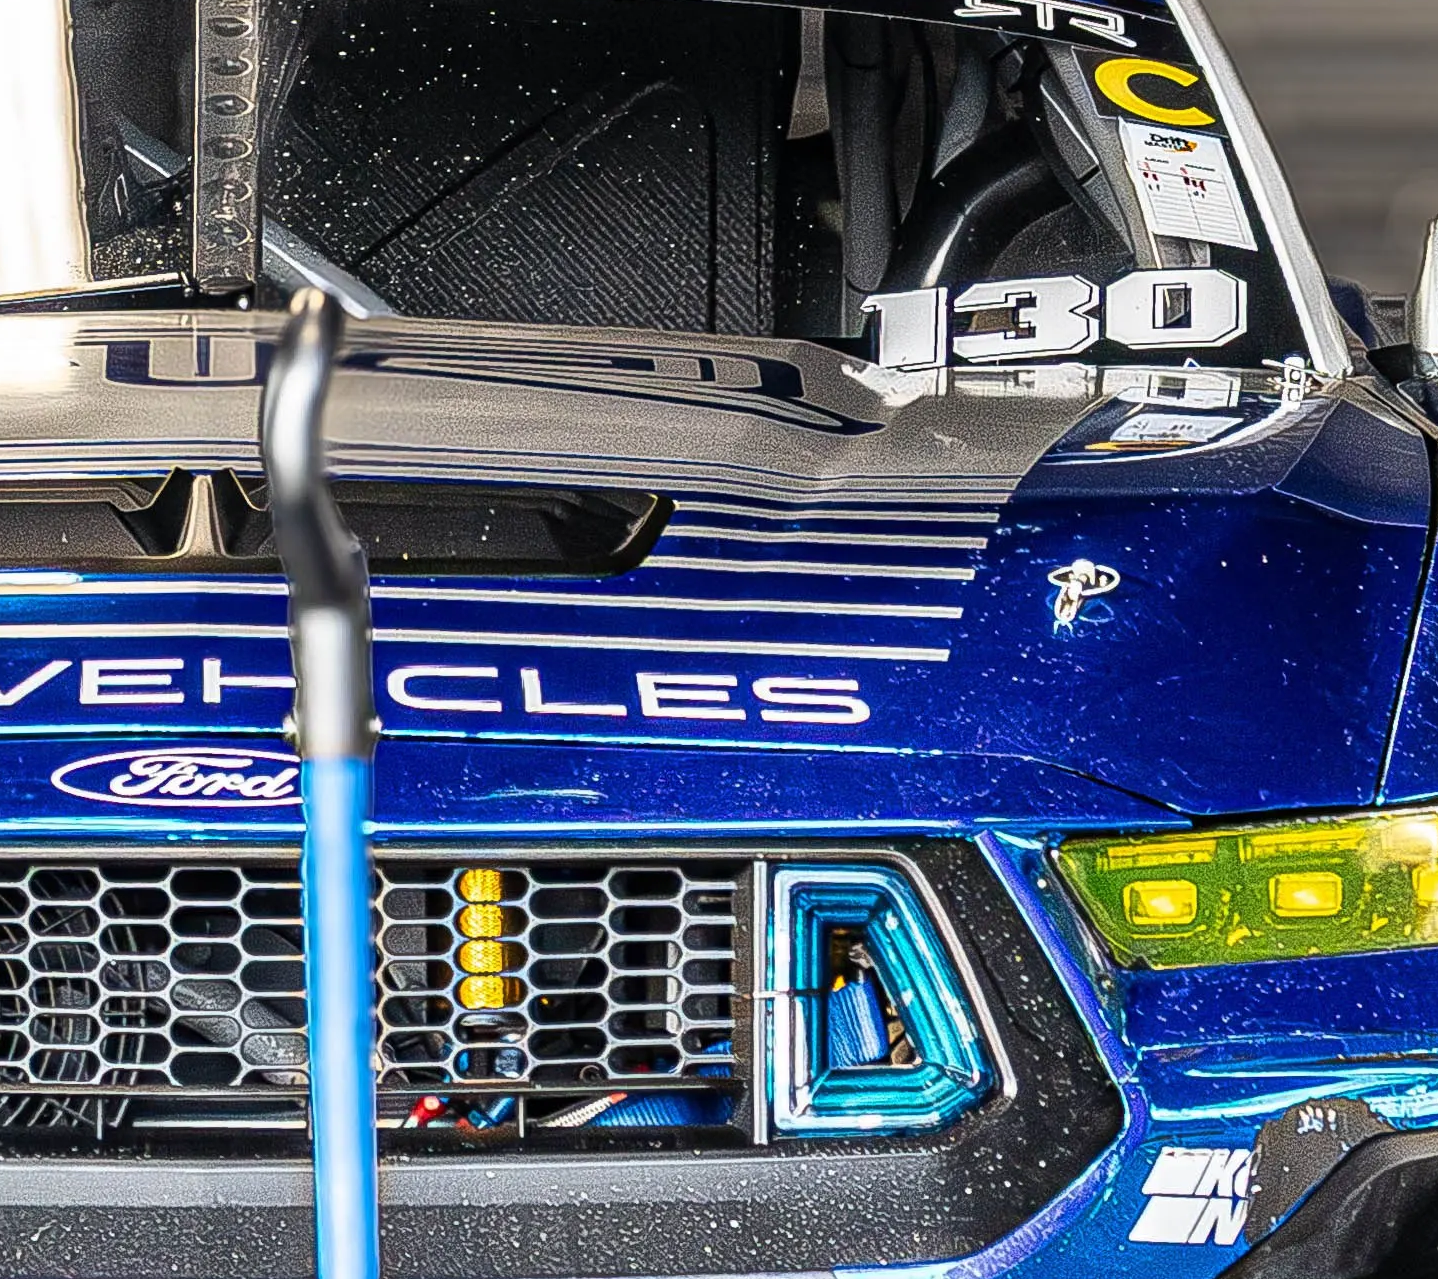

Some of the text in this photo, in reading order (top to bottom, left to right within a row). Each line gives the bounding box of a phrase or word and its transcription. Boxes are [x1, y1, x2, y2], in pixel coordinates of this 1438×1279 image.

[1095, 58, 1216, 126] C
[860, 268, 1248, 373] 130
[109, 755, 300, 799] Ford
